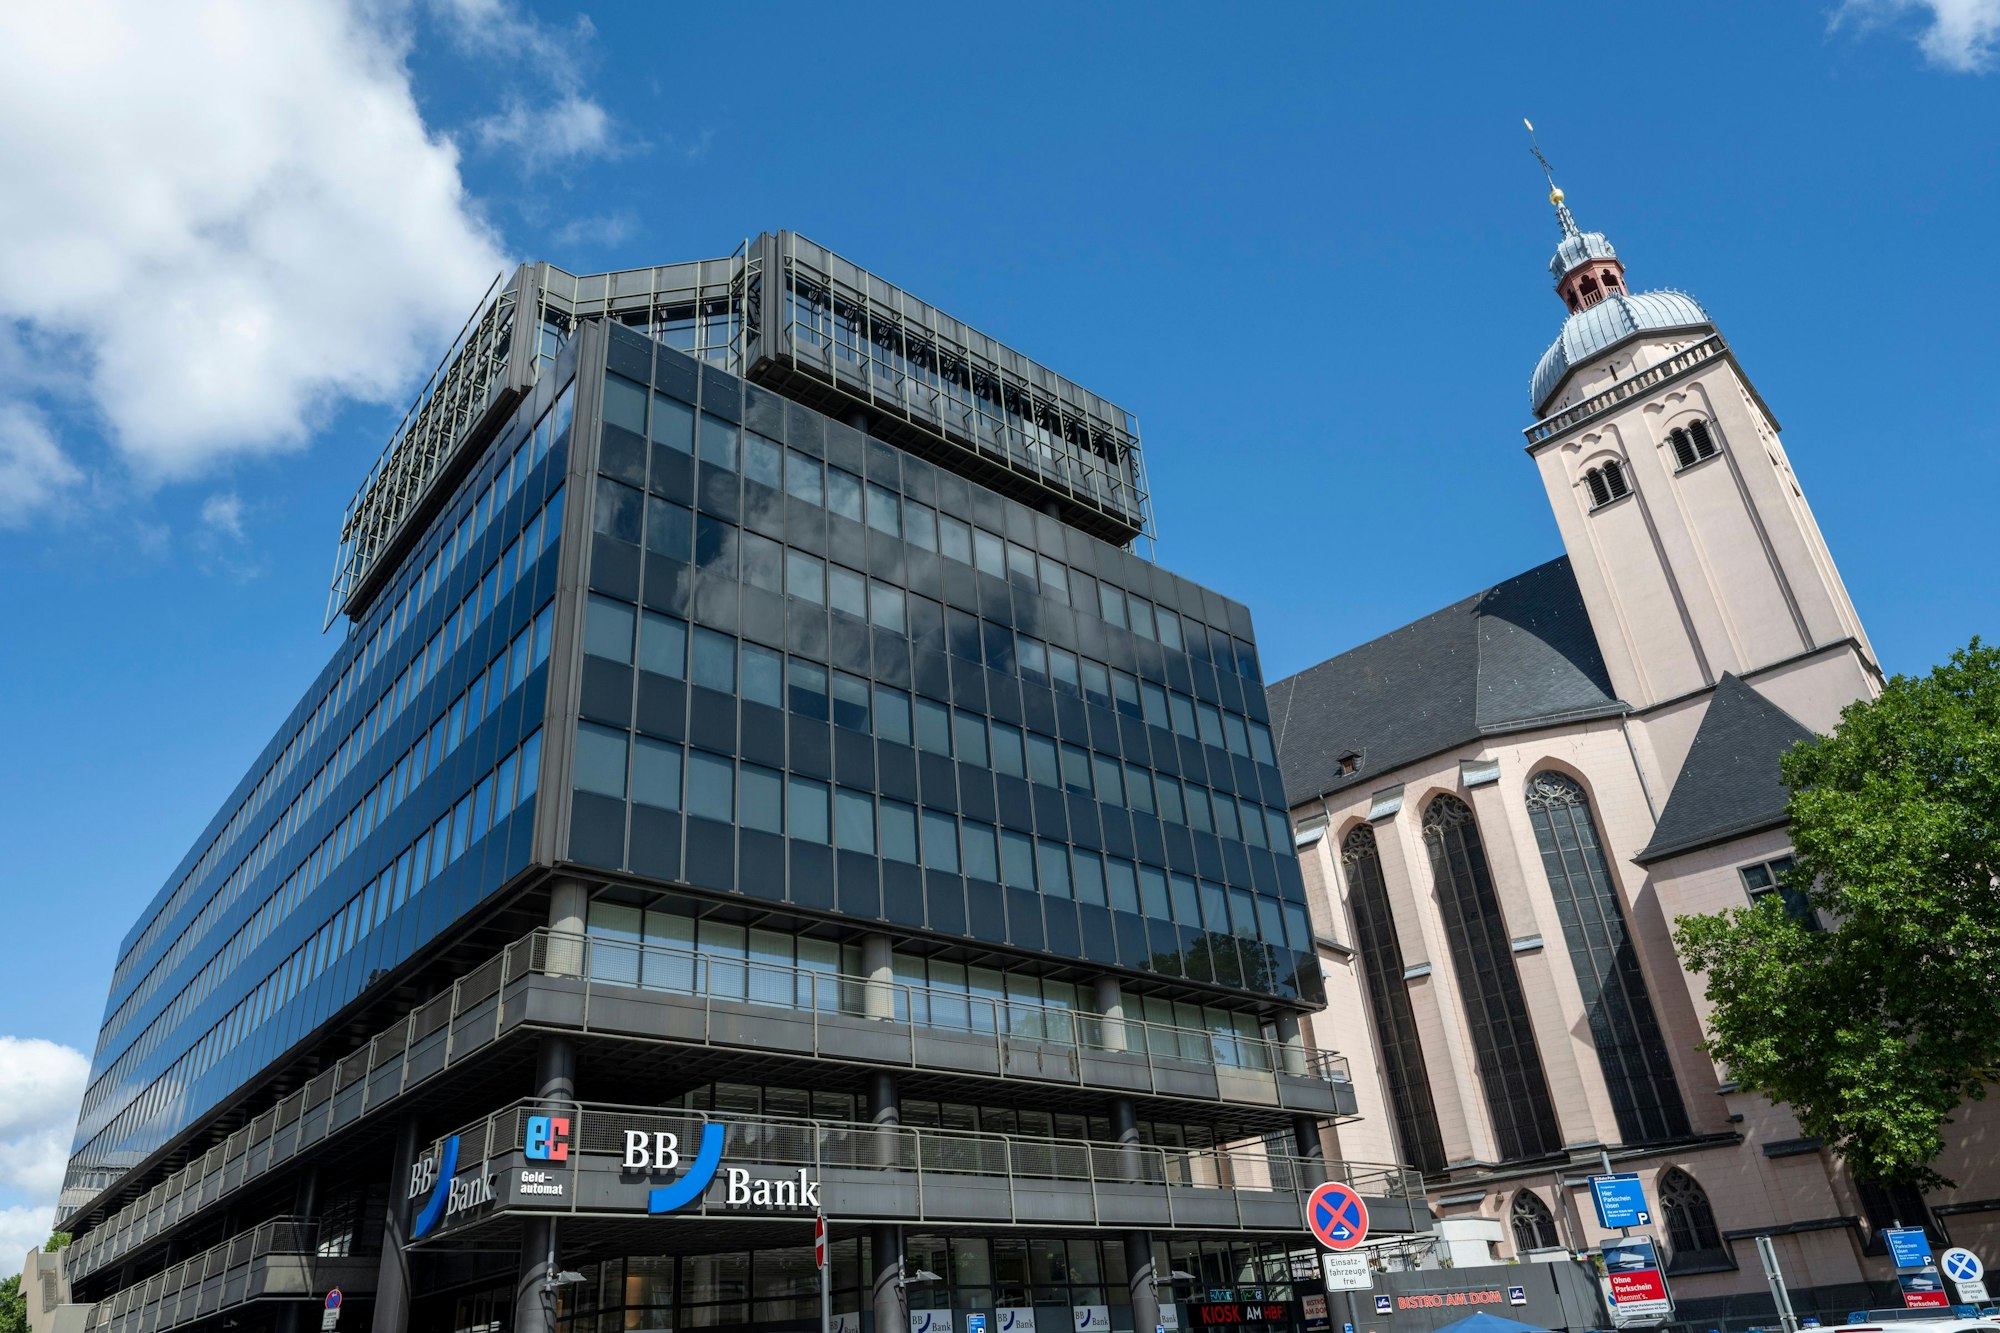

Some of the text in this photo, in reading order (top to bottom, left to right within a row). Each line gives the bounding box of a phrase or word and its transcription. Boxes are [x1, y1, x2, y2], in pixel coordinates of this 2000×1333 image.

[623, 1130, 821, 1207] BB Bank
[521, 1171, 553, 1183] Geld-
[408, 1157, 494, 1216] BB Bank
[520, 1183, 563, 1196] automat
[1638, 1213, 1648, 1225] P
[1330, 1258, 1361, 1267] Einsatz-
[1923, 1256, 1931, 1265] P
[1329, 1268, 1367, 1278] fahrzeuge
[1343, 1277, 1357, 1286] frei
[1613, 1277, 1632, 1285] Ohne
[1615, 1283, 1652, 1293] Parkschein
[1398, 1294, 1443, 1310] BISTRO
[1446, 1292, 1467, 1306] AM
[1469, 1290, 1502, 1305] DOM
[997, 1313, 1034, 1329] BB Bank
[1075, 1311, 1109, 1326] BB Bank
[1161, 1315, 1177, 1324] Bank
[1201, 1305, 1284, 1325] KIOSK AM HBF
[912, 1315, 952, 1332] BB Bank
